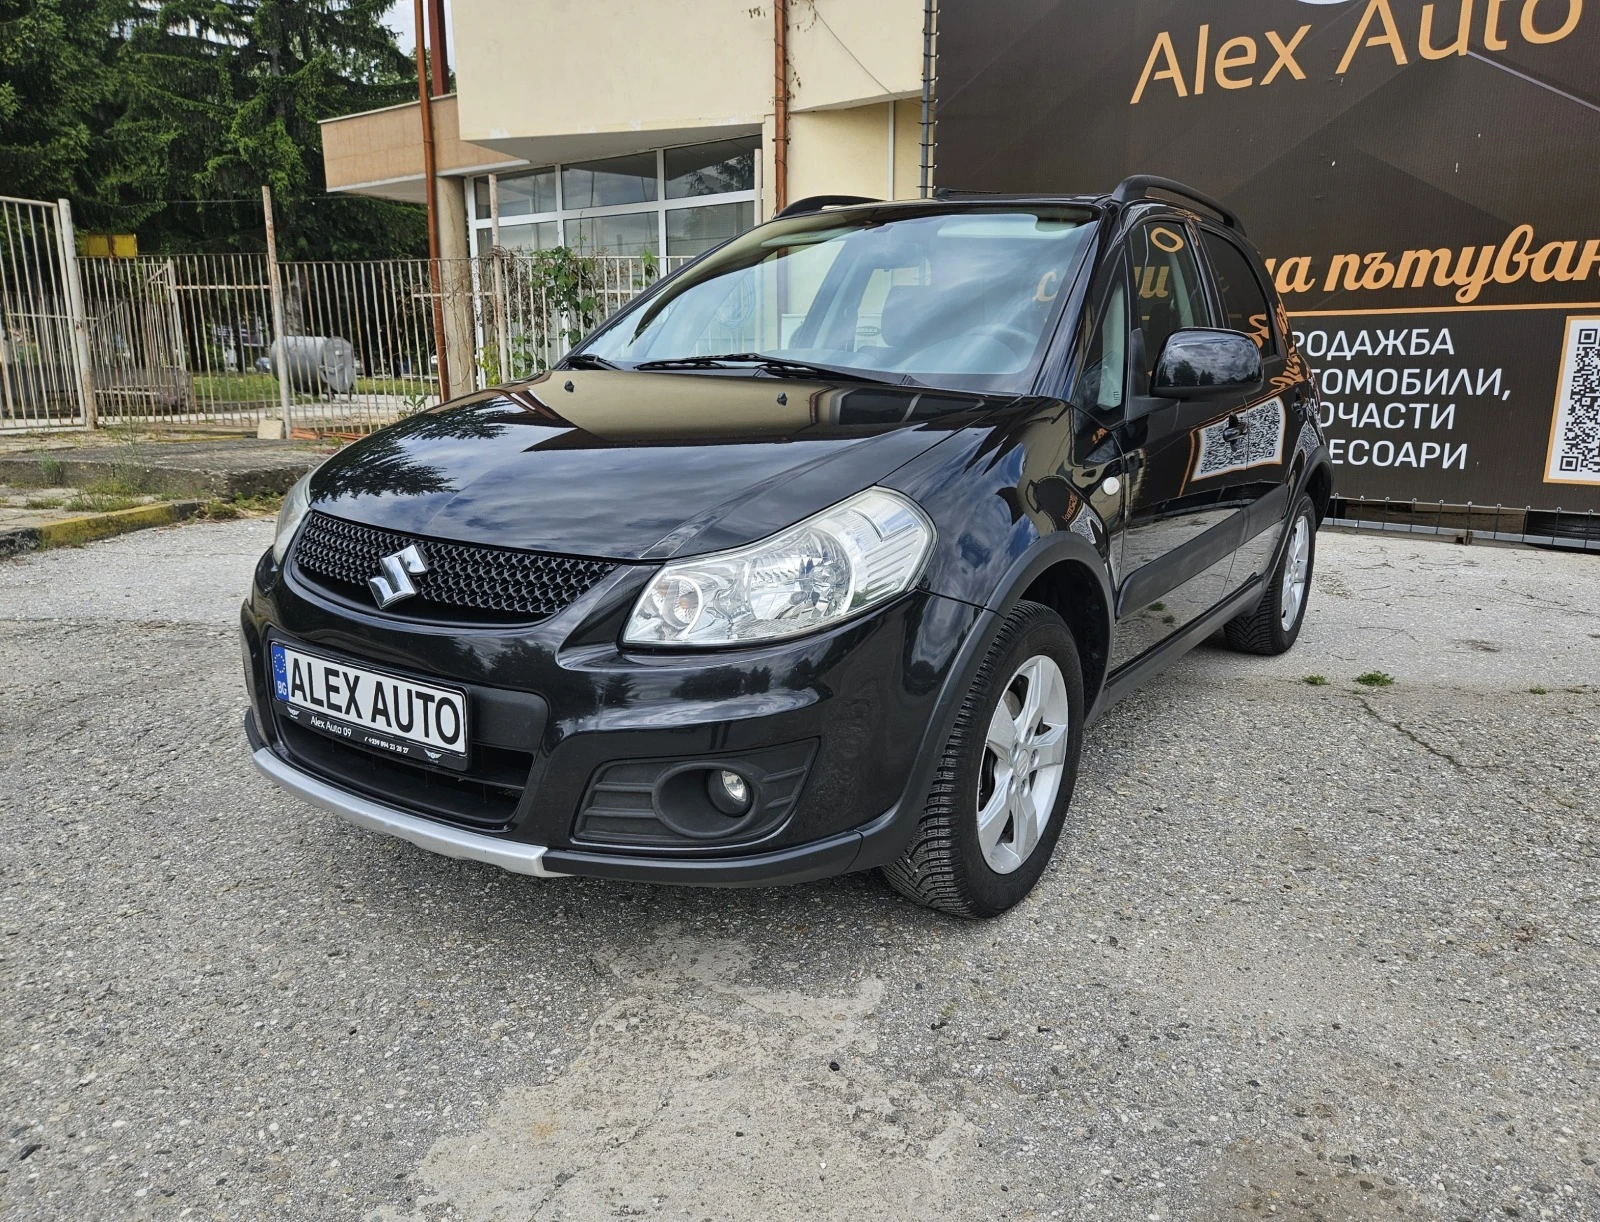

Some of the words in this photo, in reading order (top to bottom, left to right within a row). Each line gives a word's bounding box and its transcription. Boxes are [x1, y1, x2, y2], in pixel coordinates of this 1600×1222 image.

[1130, 24, 1312, 104] Alex
[1335, 0, 1583, 74] Auto
[1292, 328, 1455, 361] РОДАЖБА
[1311, 368, 1511, 401] ОМОБИЛИ,
[1320, 402, 1456, 430] ОЧАСТИ
[1329, 438, 1468, 470] ЕСОАРИ
[277, 680, 288, 696] BG
[291, 657, 364, 720] ALEX
[370, 680, 461, 746] AUTO
[310, 716, 325, 730] Alex
[325, 721, 342, 734] Auto
[342, 727, 352, 737] 09
